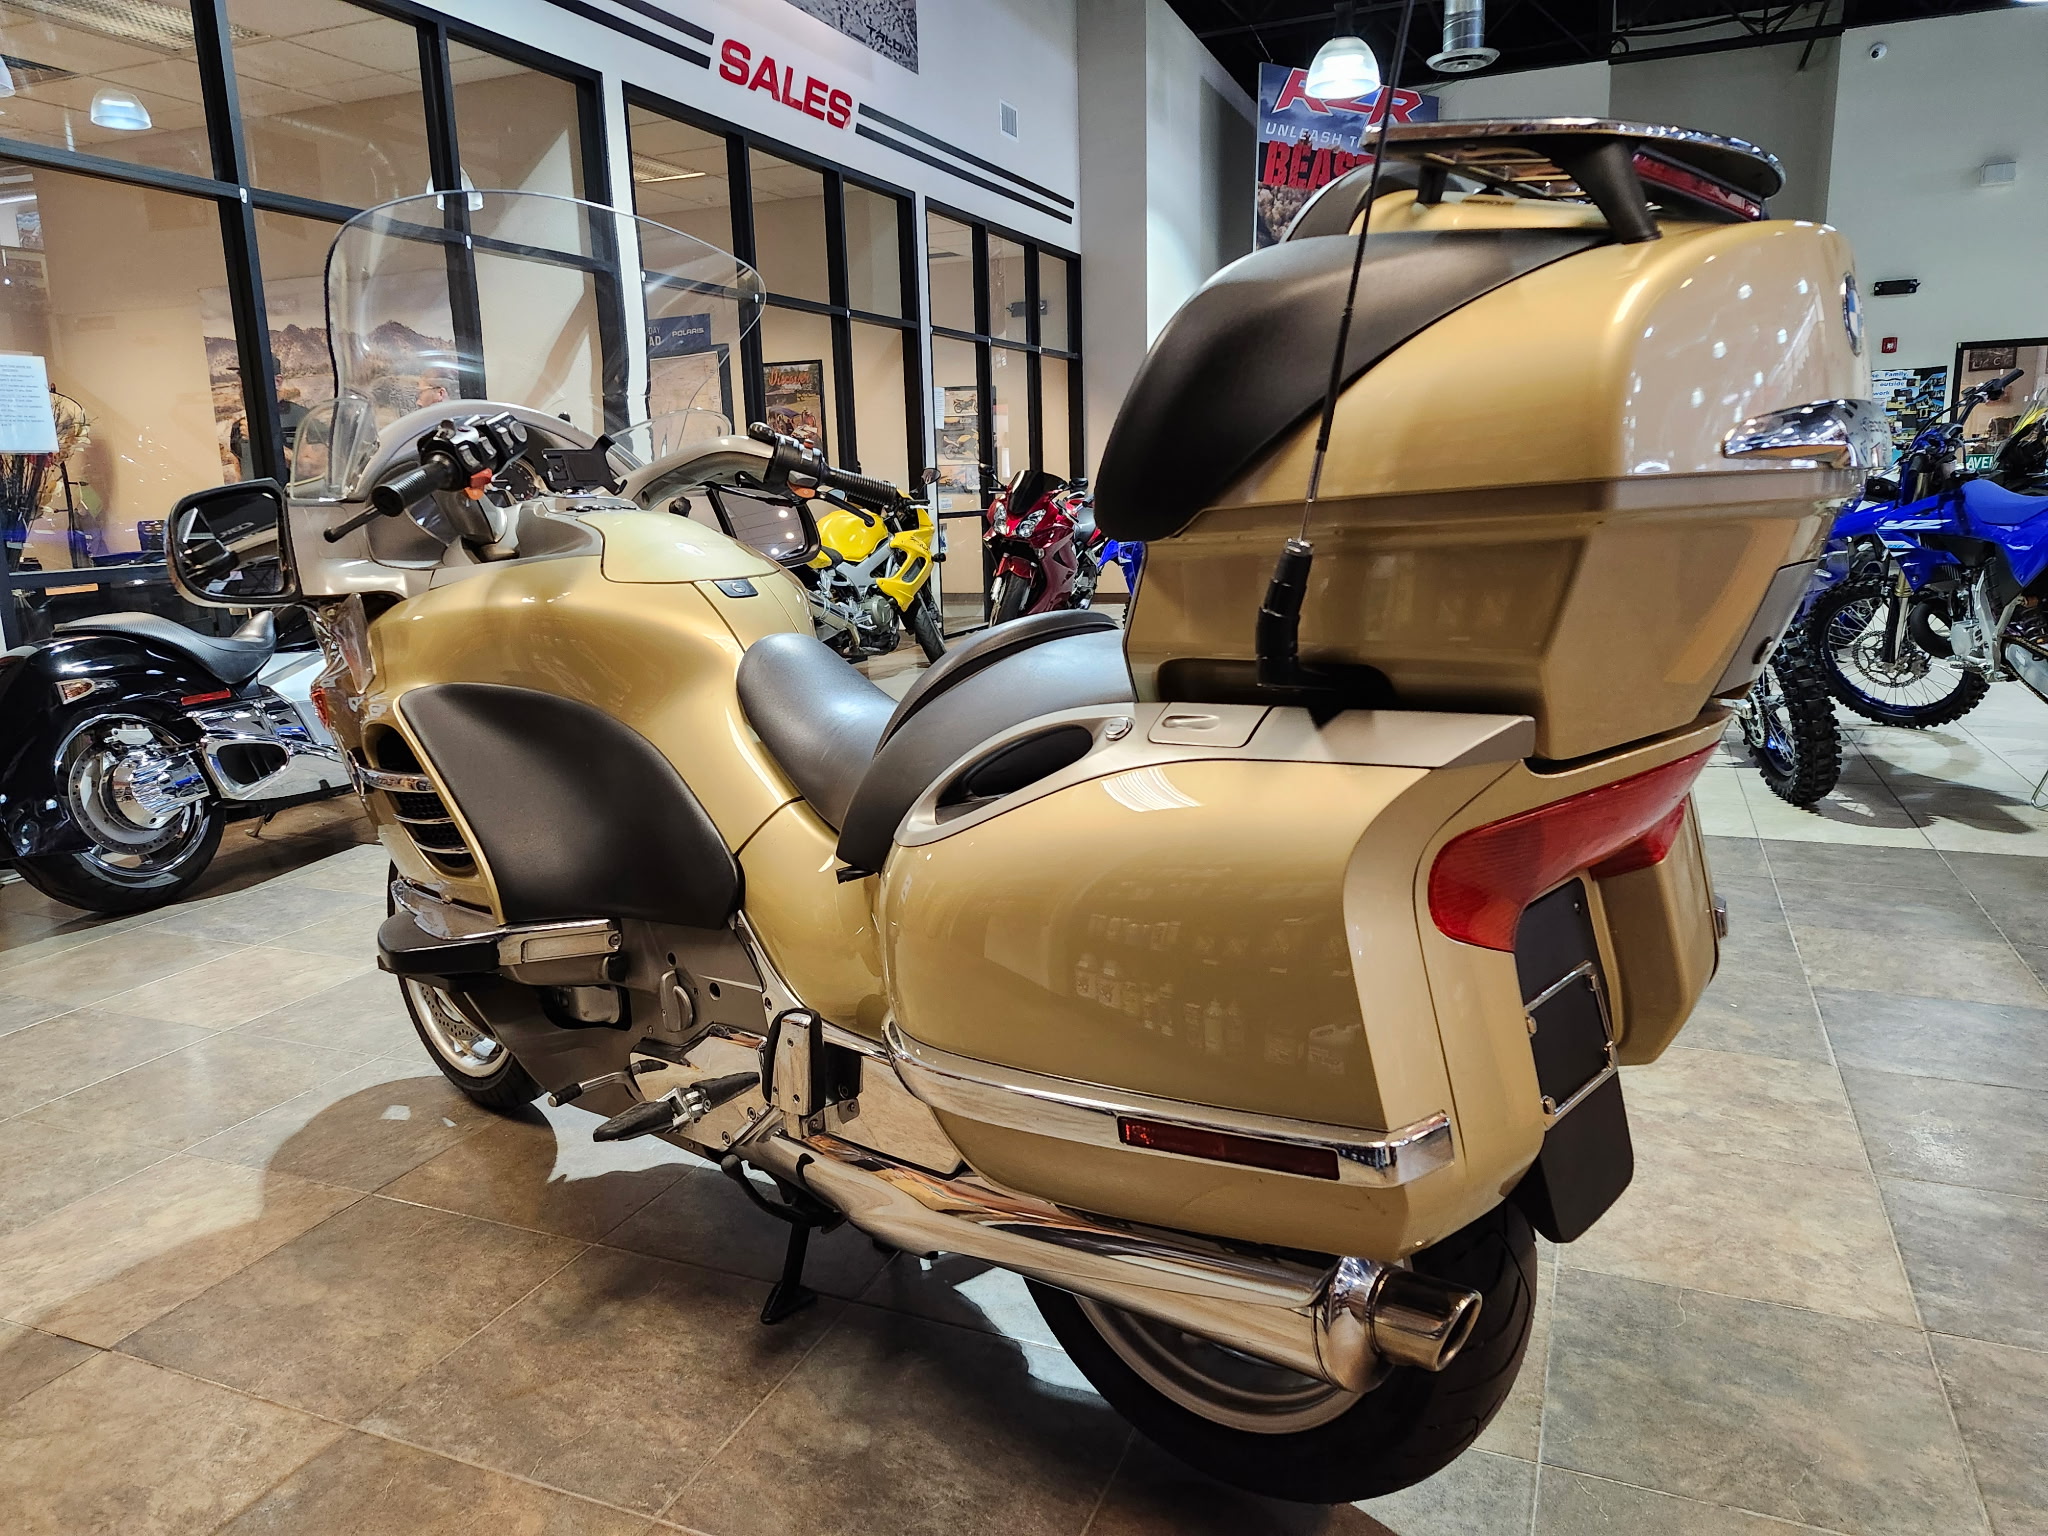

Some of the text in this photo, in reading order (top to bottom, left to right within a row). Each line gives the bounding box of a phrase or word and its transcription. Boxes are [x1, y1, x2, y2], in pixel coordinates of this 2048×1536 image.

[866, 25, 911, 57] TALON
[719, 38, 853, 130] SALES
[1265, 122, 1342, 145] UNLEASH
[672, 327, 704, 337] POLARIS
[768, 367, 811, 386] Discover
[1877, 519, 1952, 529] YZ
